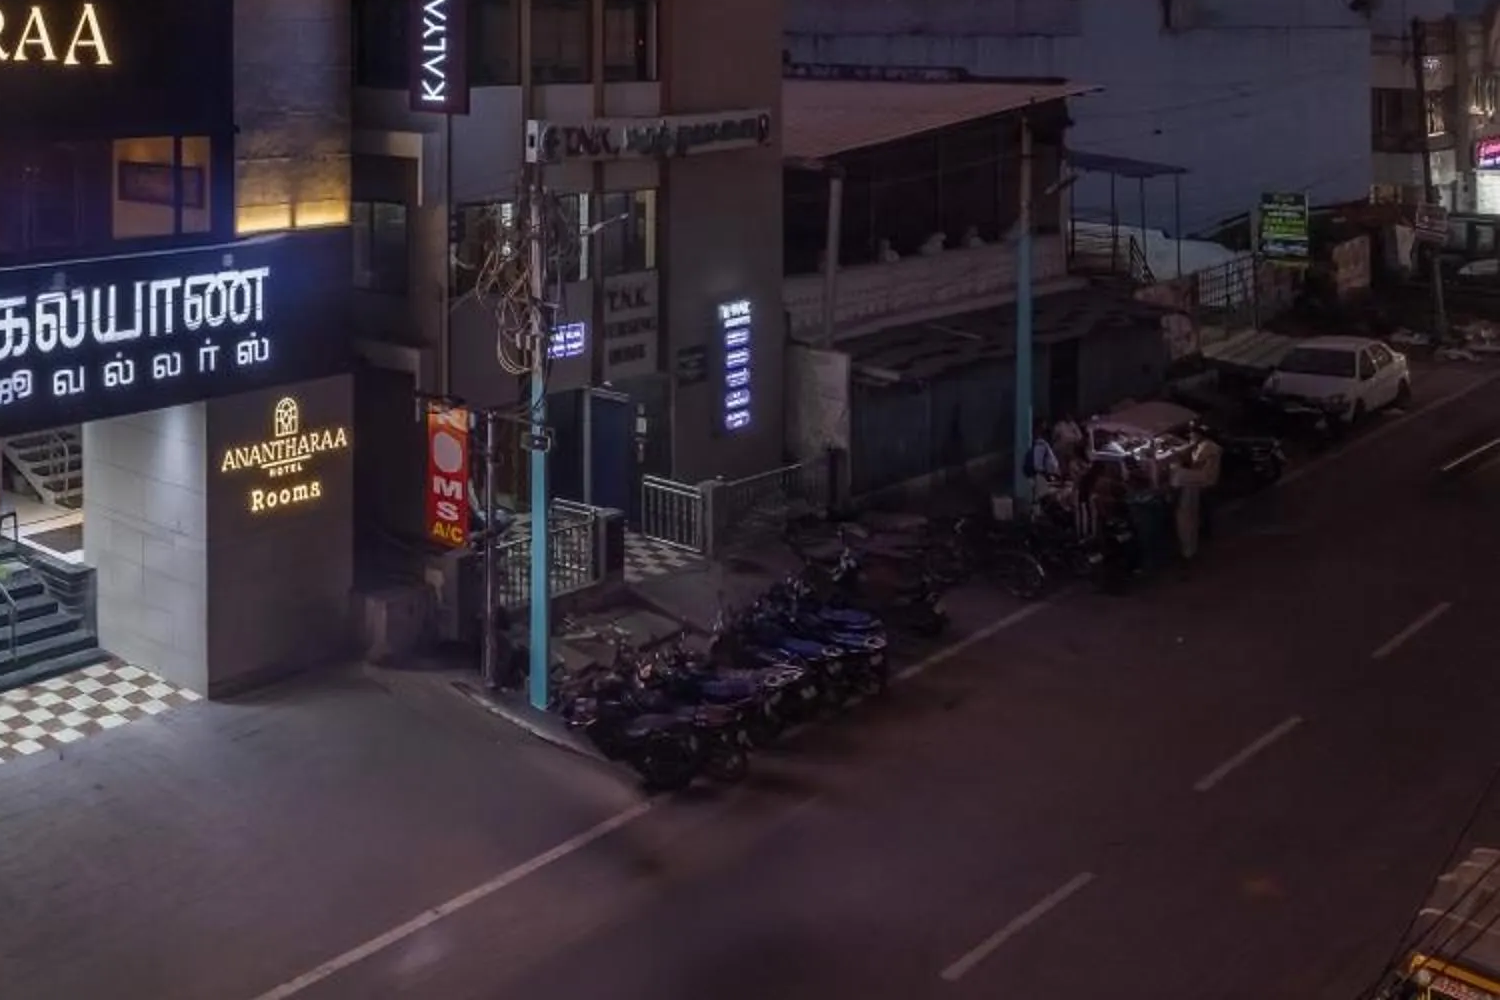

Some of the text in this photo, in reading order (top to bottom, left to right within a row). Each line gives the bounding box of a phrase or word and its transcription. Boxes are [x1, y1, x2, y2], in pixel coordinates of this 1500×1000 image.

[220, 427, 348, 473] ANANTHARAA
[268, 462, 304, 478] HOTEL
[251, 481, 322, 512] Rooms
